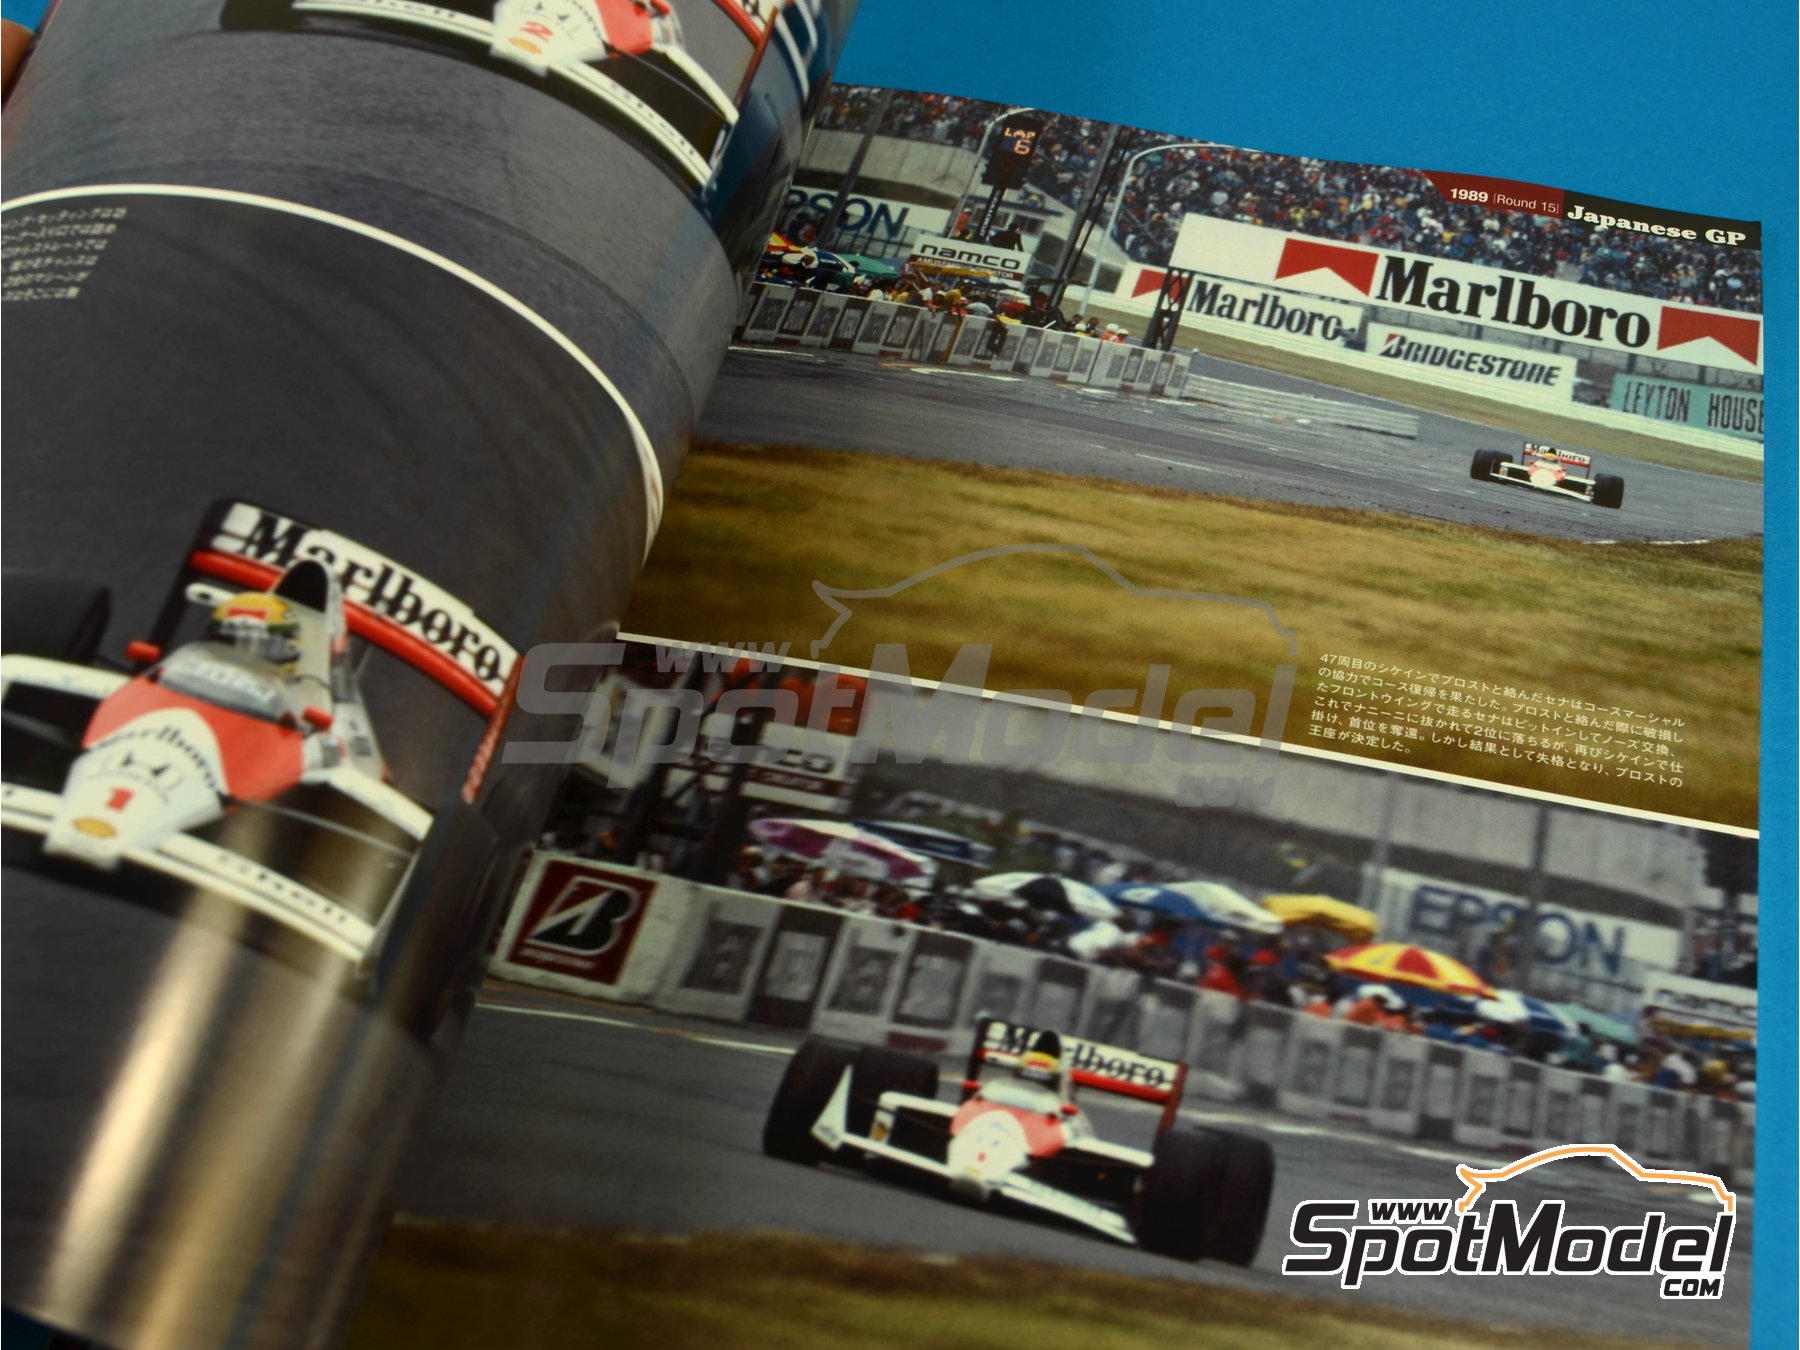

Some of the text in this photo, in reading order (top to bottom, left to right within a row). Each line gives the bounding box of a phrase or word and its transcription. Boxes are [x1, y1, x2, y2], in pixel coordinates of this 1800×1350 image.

[1004, 127, 1036, 139] LAP
[1013, 140, 1031, 155] 6
[1450, 187, 1489, 203] 1989
[1567, 204, 1697, 241] Japanese
[1705, 228, 1746, 246] GP
[920, 243, 1021, 270] namco
[1187, 280, 1343, 341] Marlboro
[1375, 256, 1650, 348] Marlboro
[1380, 334, 1561, 387] BRIDGESTONE
[1622, 380, 1691, 423] LEYTON
[1308, 724, 1411, 754] 王座が決定した。
